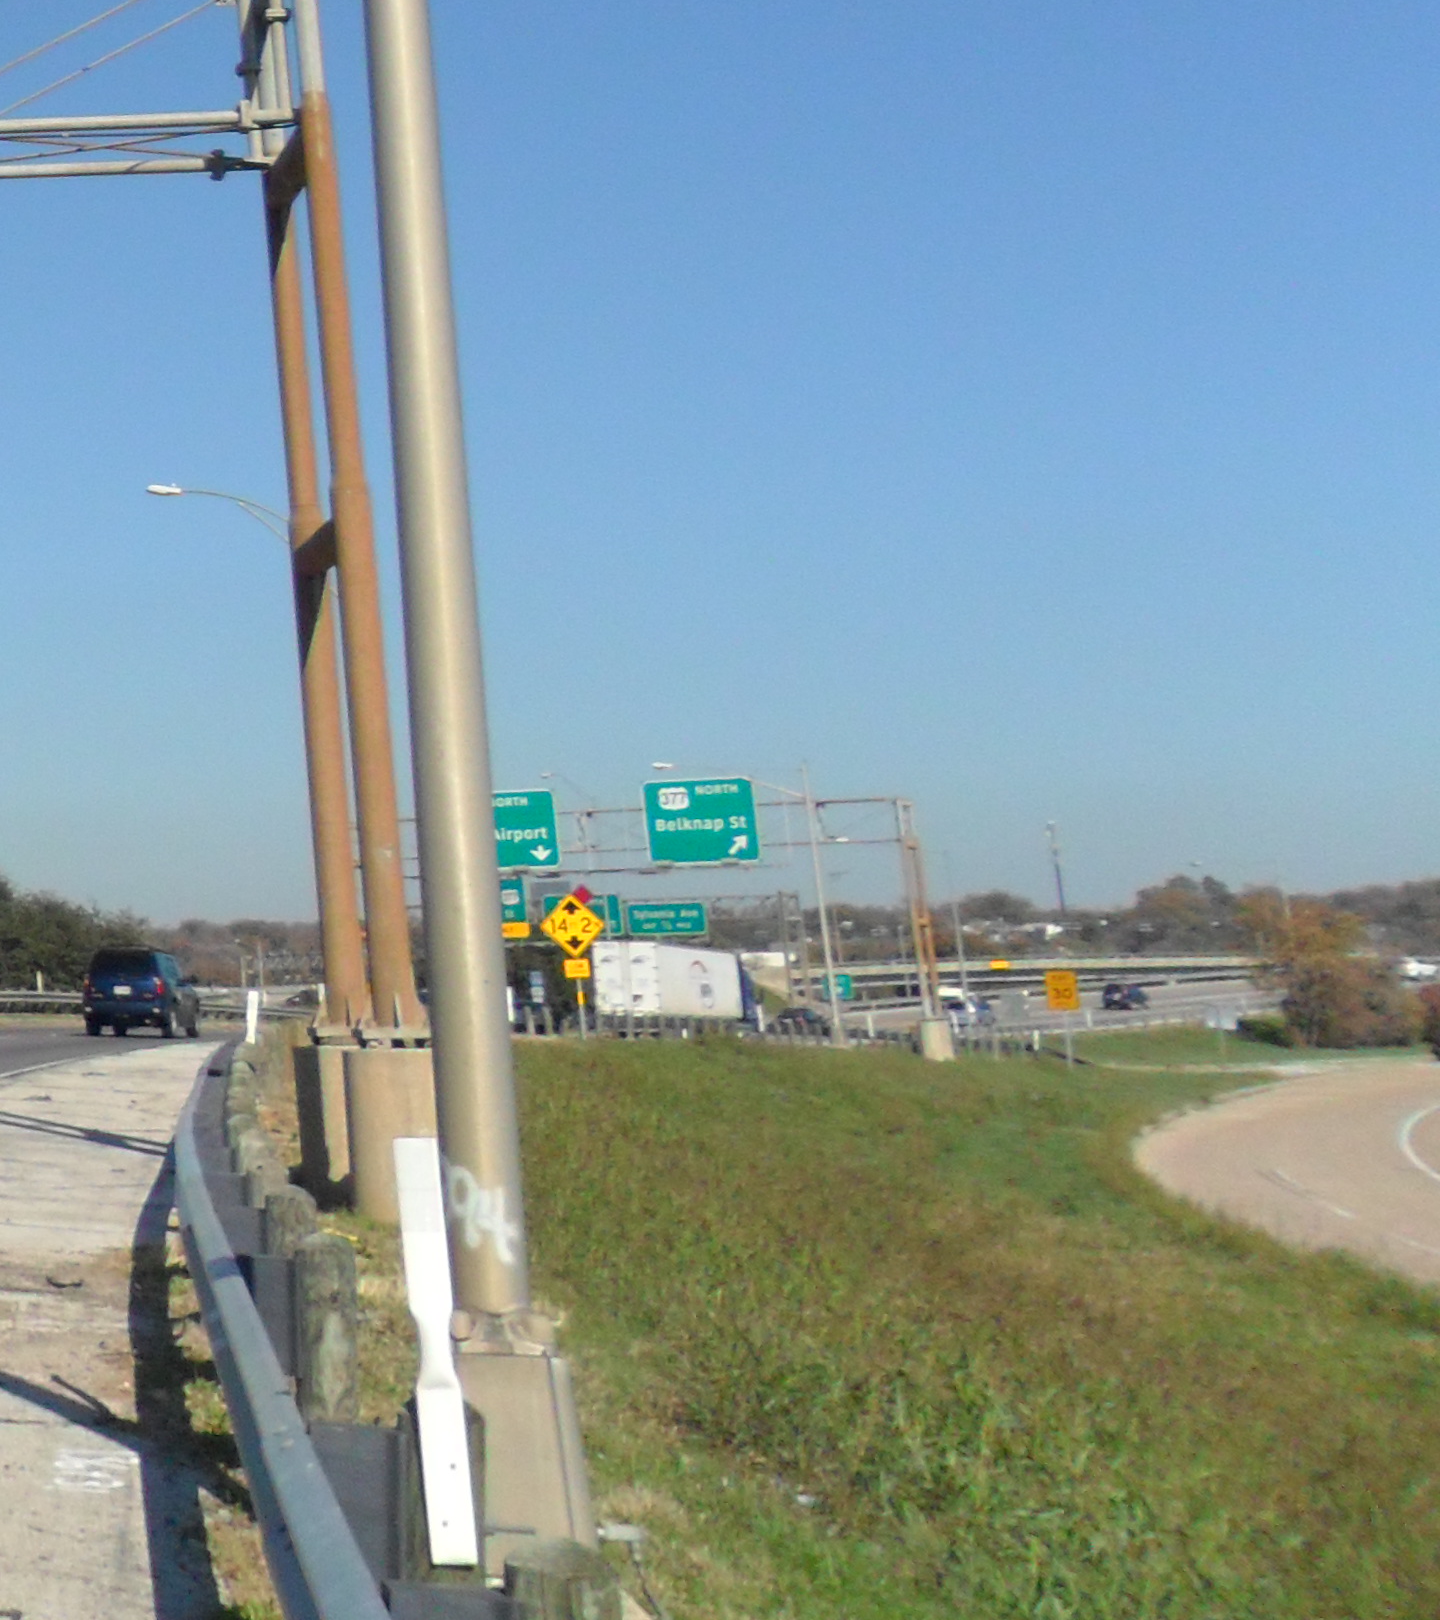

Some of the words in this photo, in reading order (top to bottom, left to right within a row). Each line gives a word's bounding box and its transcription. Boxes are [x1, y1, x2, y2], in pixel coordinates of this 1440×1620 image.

[694, 783, 739, 795] NORTH
[655, 817, 725, 832] Belknap
[728, 815, 748, 829] St
